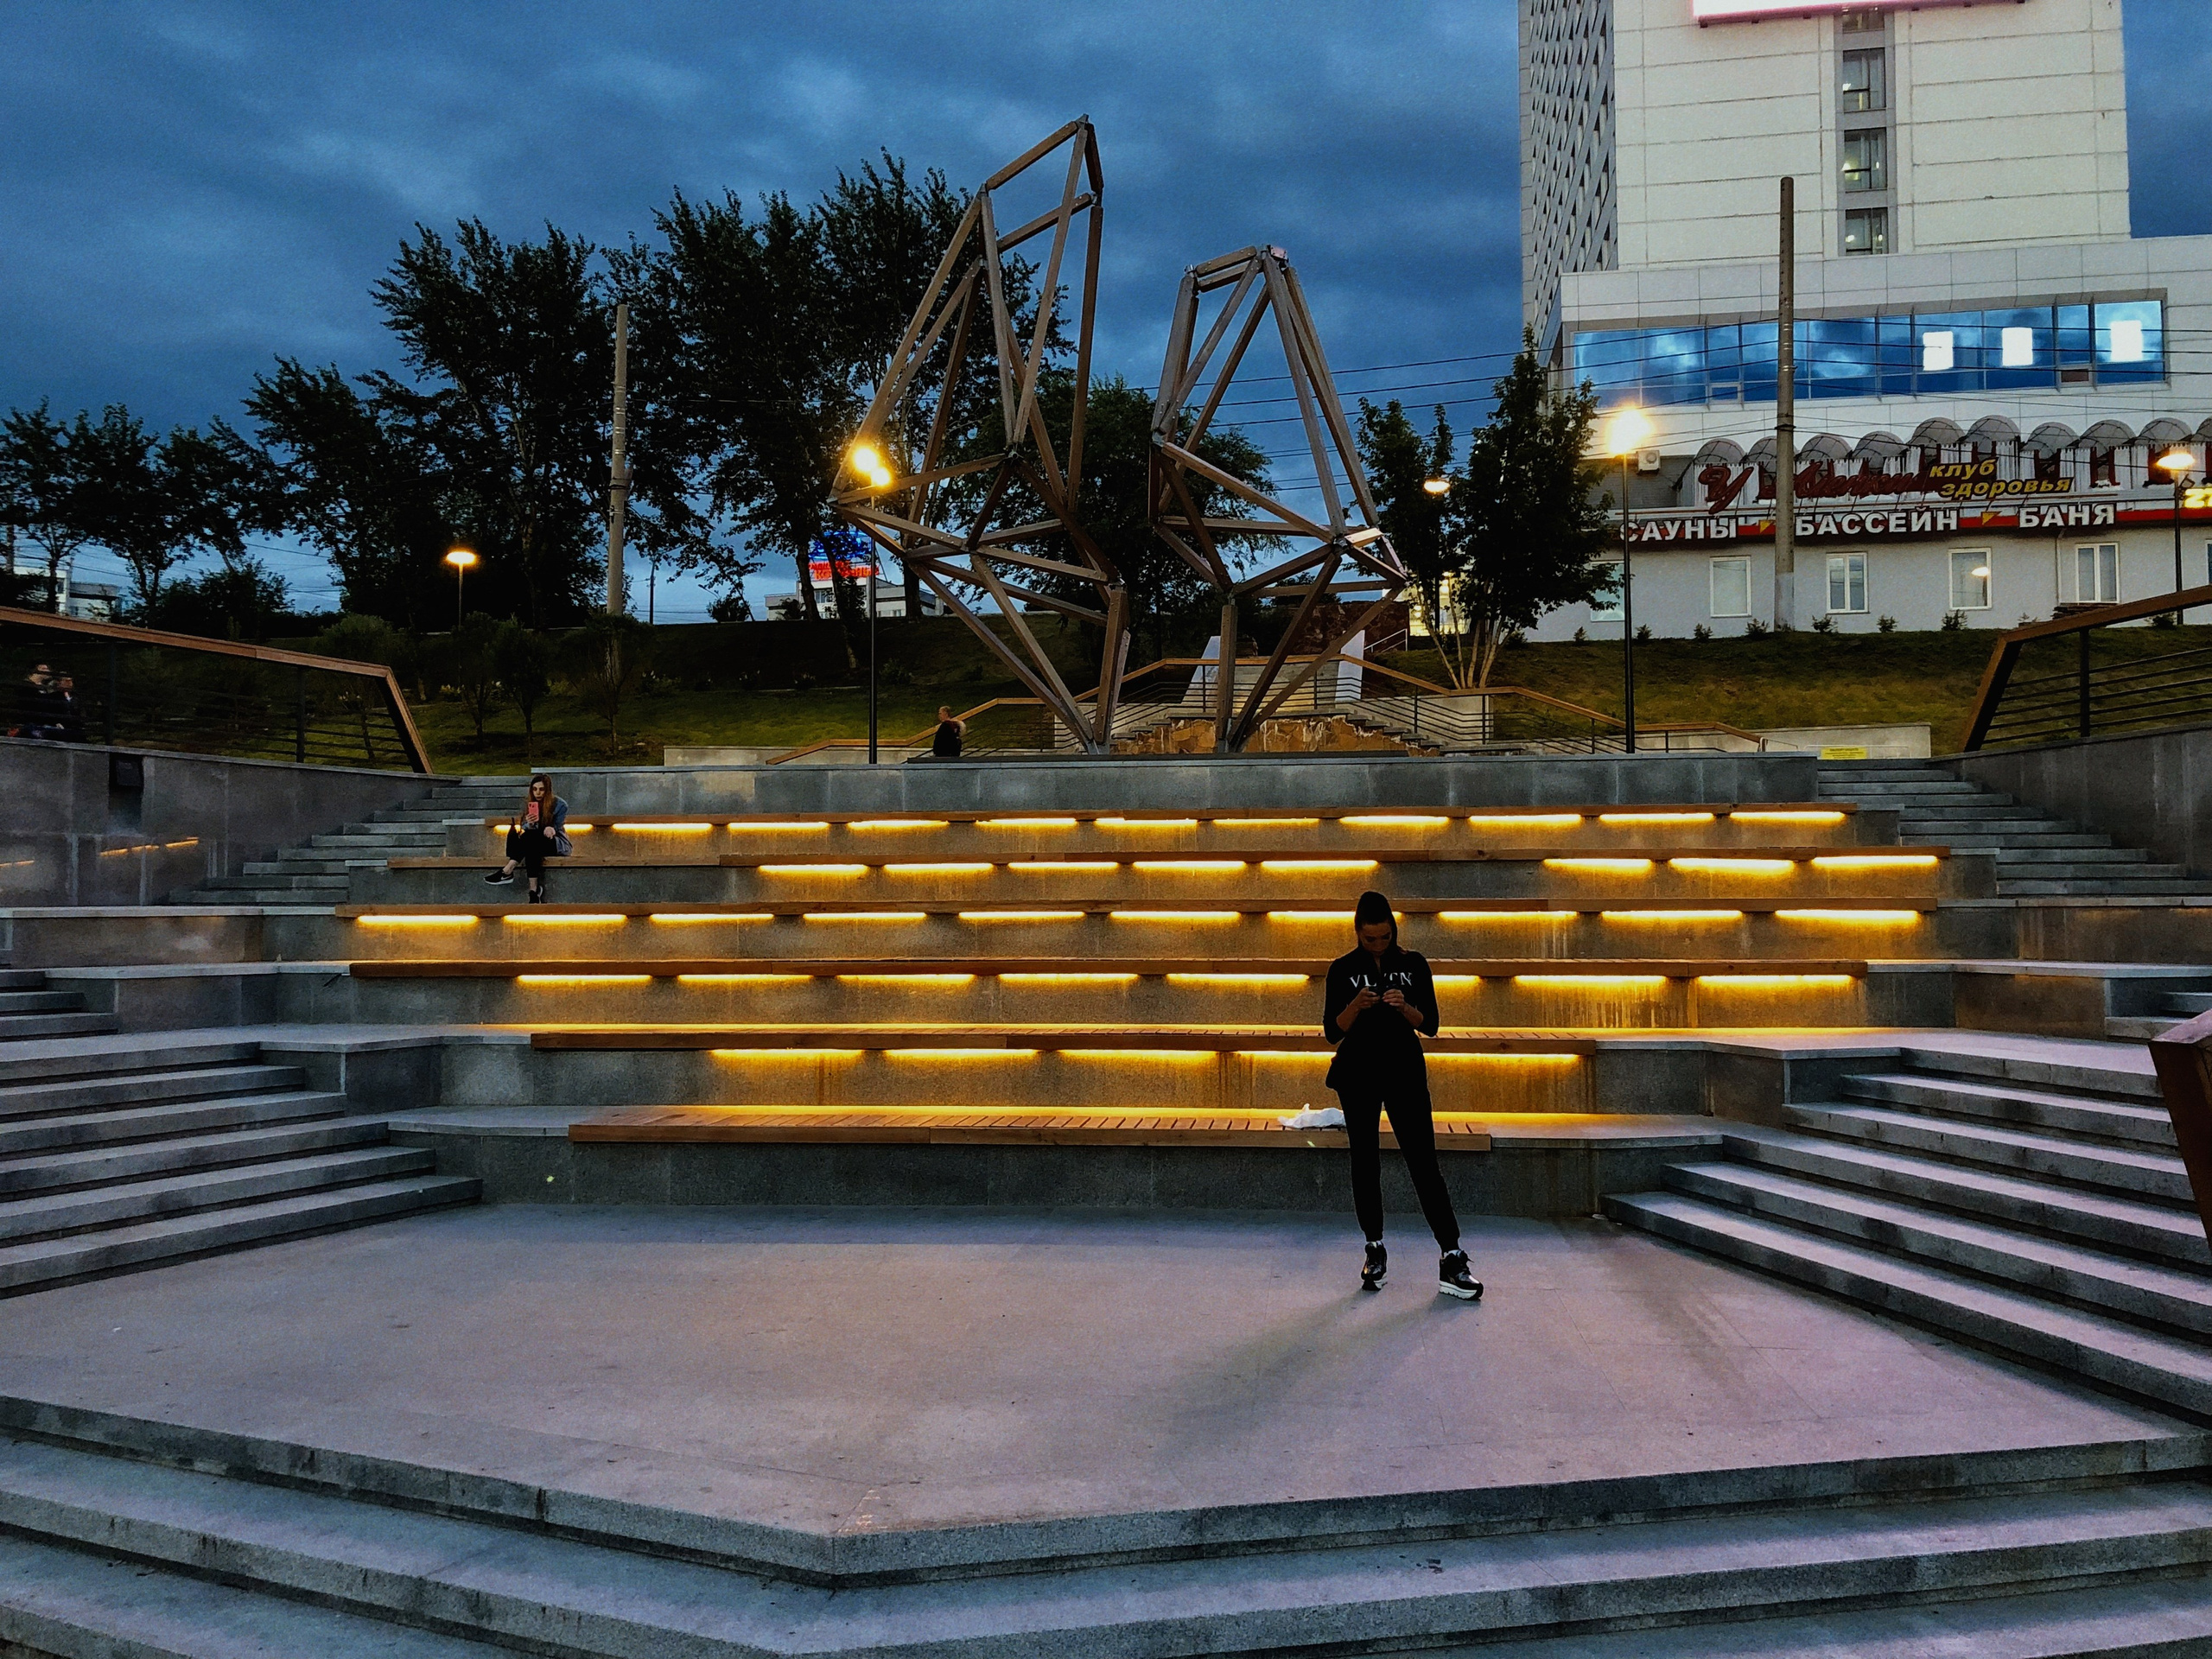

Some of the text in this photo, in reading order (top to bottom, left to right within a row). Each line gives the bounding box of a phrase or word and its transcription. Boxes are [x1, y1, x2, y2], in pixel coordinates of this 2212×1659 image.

[1929, 458, 1998, 480] клуб
[1939, 478, 2072, 499] здоровья
[1619, 503, 2115, 543] САУНЫ БАССЕЙН БАНЯ
